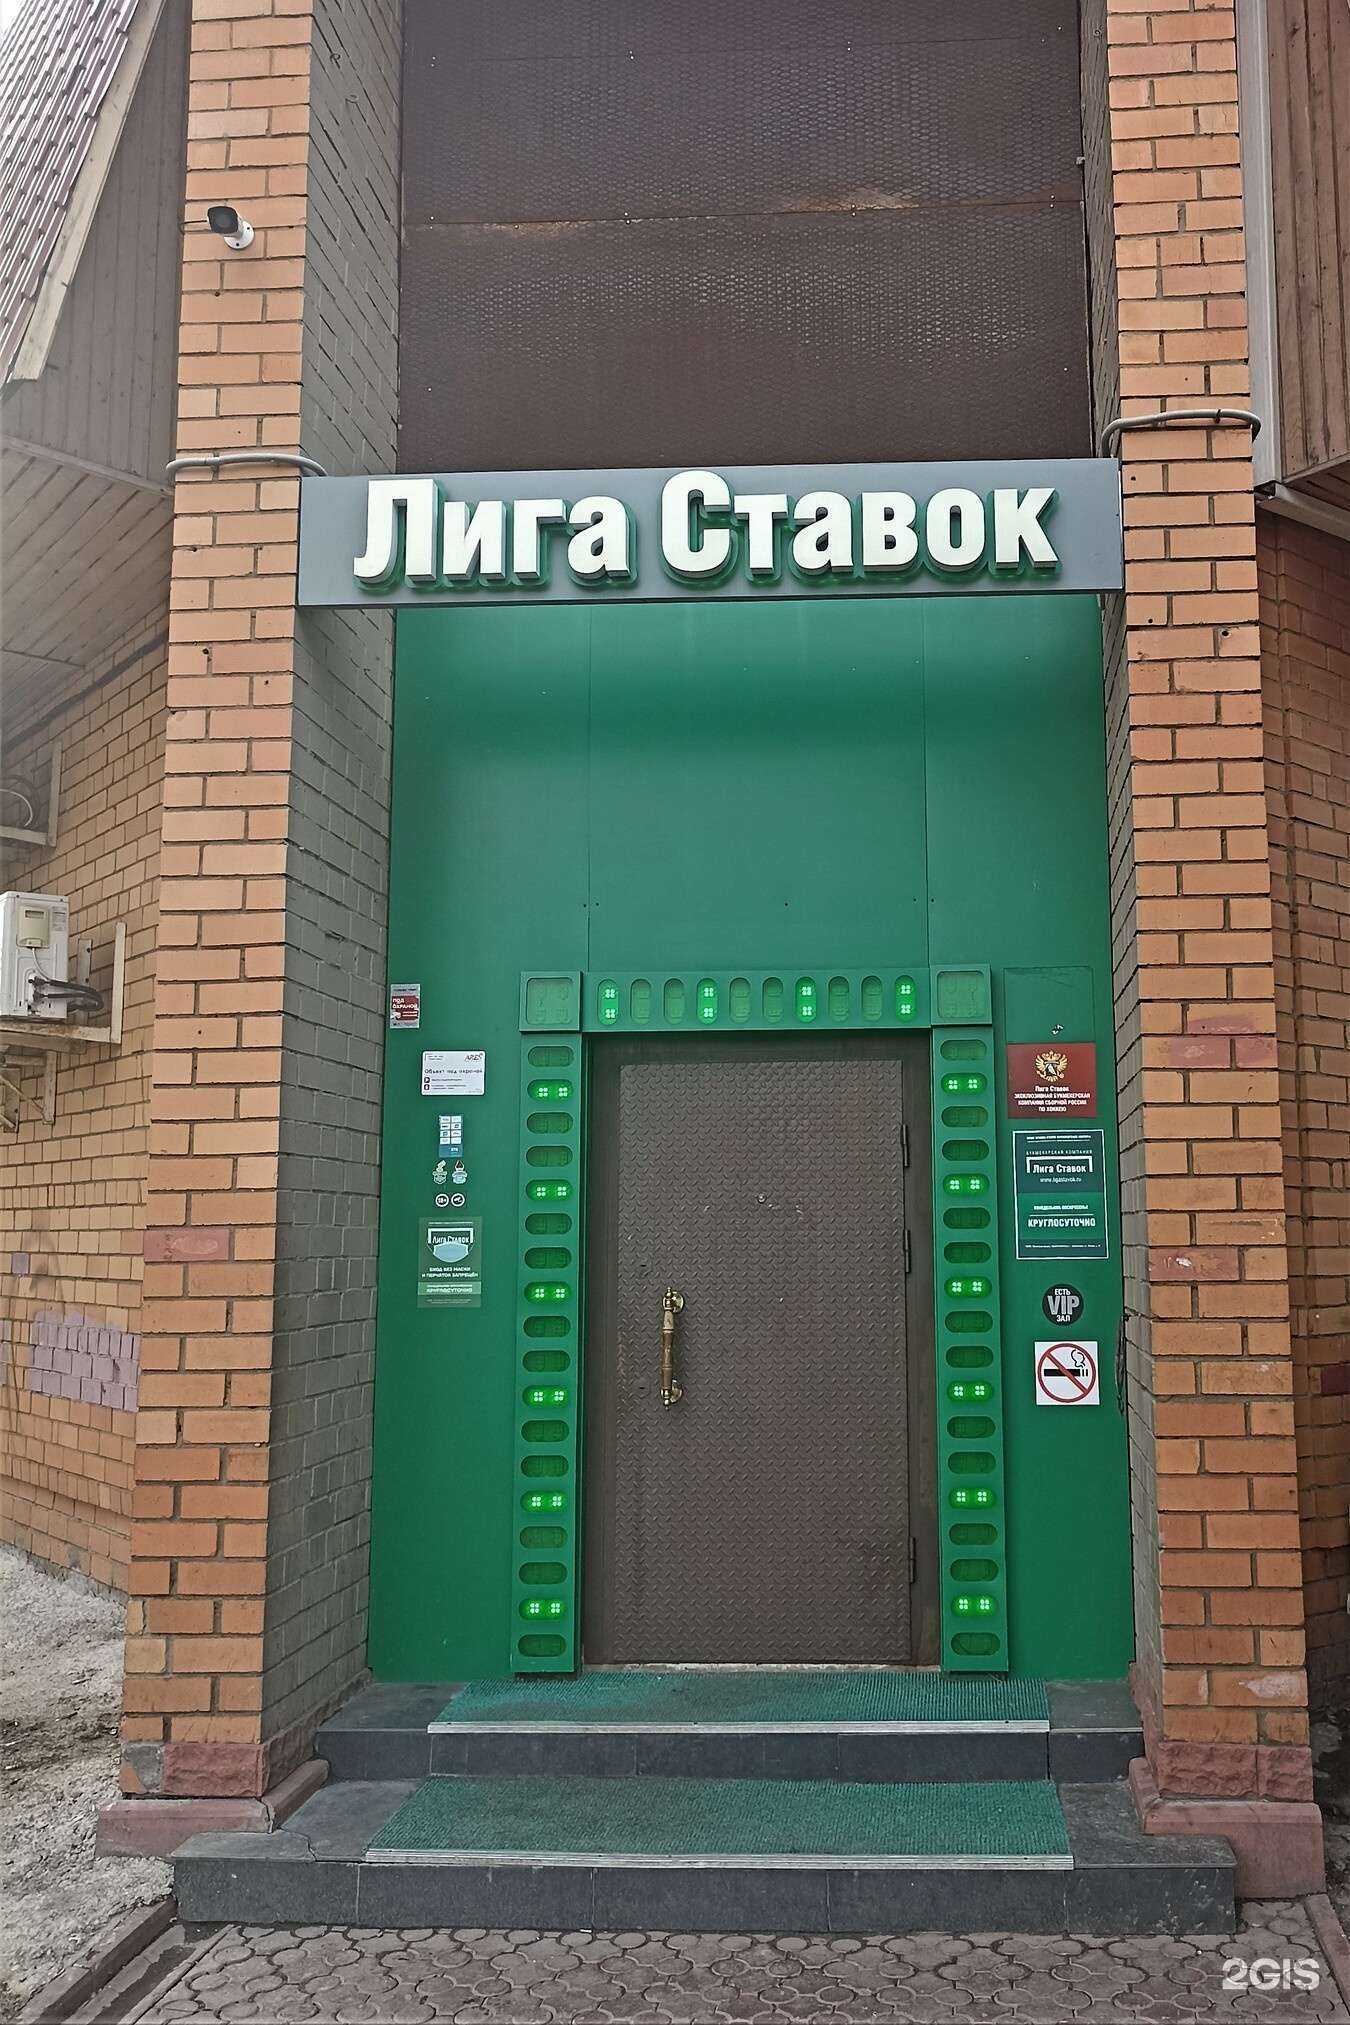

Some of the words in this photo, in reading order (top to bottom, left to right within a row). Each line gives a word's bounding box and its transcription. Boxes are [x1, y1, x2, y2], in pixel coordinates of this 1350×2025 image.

[353, 478, 632, 585] Лига
[660, 470, 1058, 580] Ставок
[1033, 1164, 1054, 1174] Лига
[1056, 1163, 1087, 1173] Ставок
[1028, 1218, 1096, 1227] КРУГЛОСУТОЧНО
[1047, 1295, 1080, 1315] VIP
[1056, 1314, 1071, 1322] ЗАЛ
